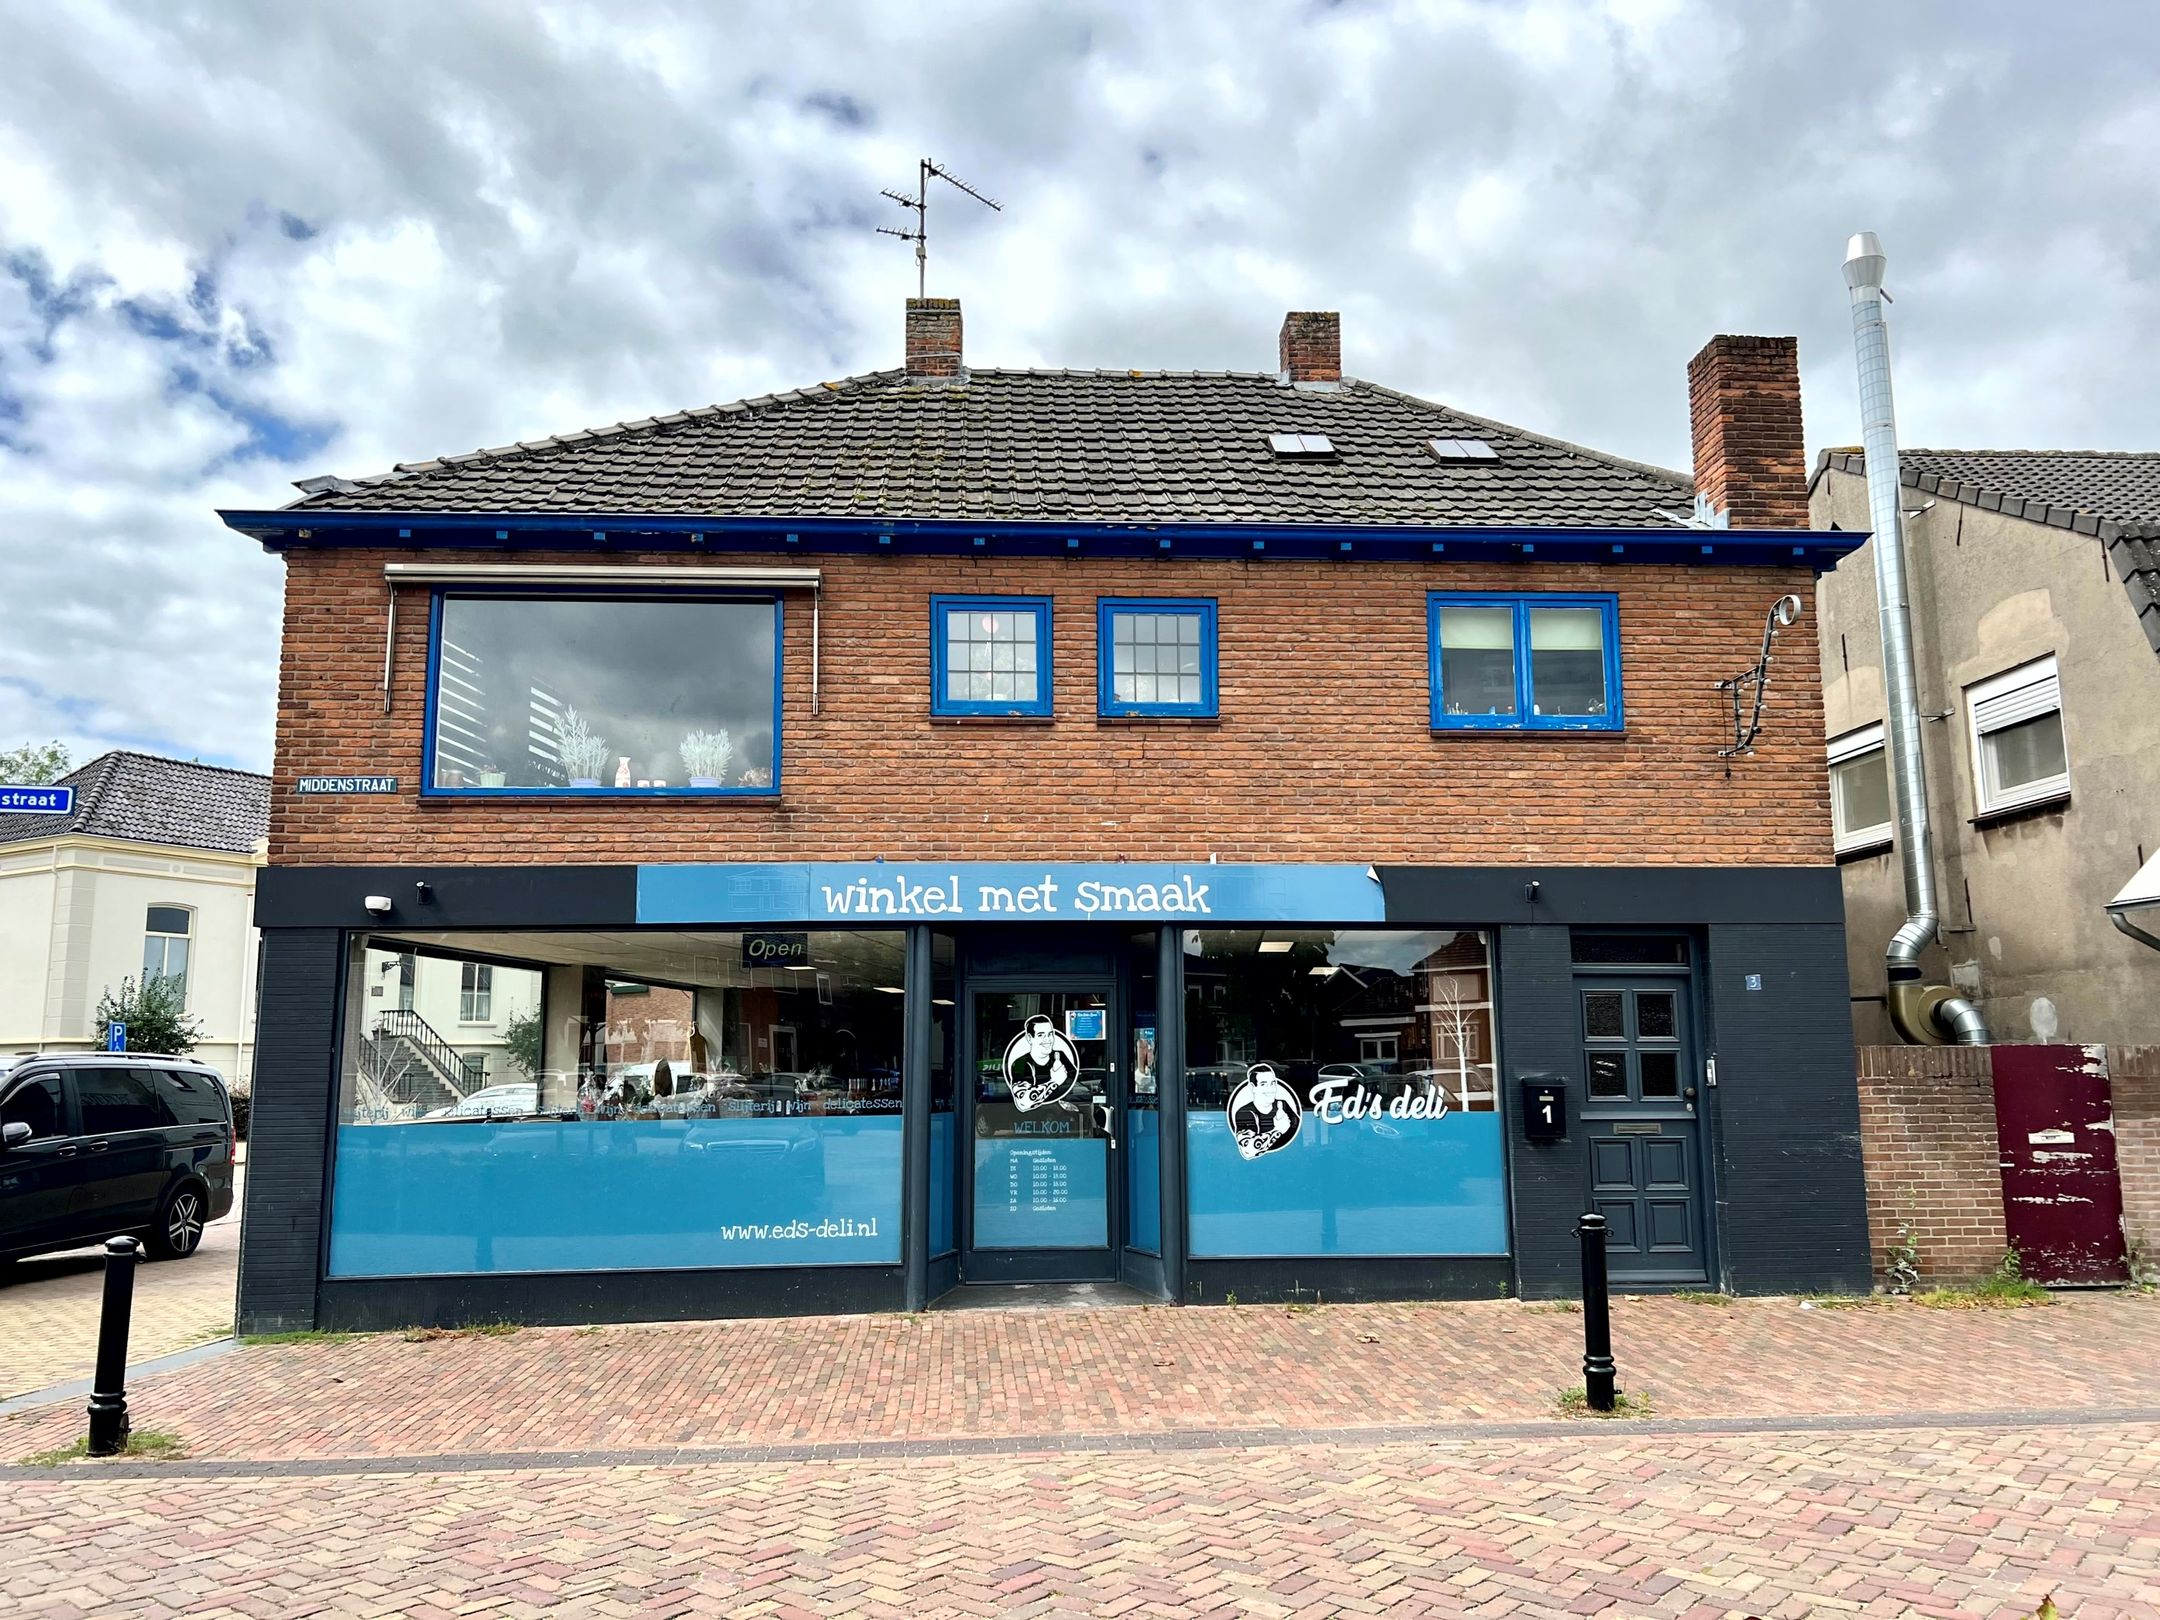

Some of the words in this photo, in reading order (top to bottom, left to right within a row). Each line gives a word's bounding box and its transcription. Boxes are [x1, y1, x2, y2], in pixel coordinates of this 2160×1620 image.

[299, 778, 394, 792] MIDDENSTRAAT
[1, 792, 57, 807] straat
[821, 875, 963, 914] winkel
[978, 874, 1059, 913] met
[748, 939, 802, 960] Open
[114, 1025, 123, 1042] P
[822, 1098, 903, 1111] delicatessen
[1308, 1078, 1383, 1124] Ed's
[1389, 1084, 1449, 1120] deli
[1541, 1104, 1552, 1124] 1
[1013, 1120, 1070, 1134] WELKOM
[720, 1217, 878, 1240] www.eds-deli.nl
